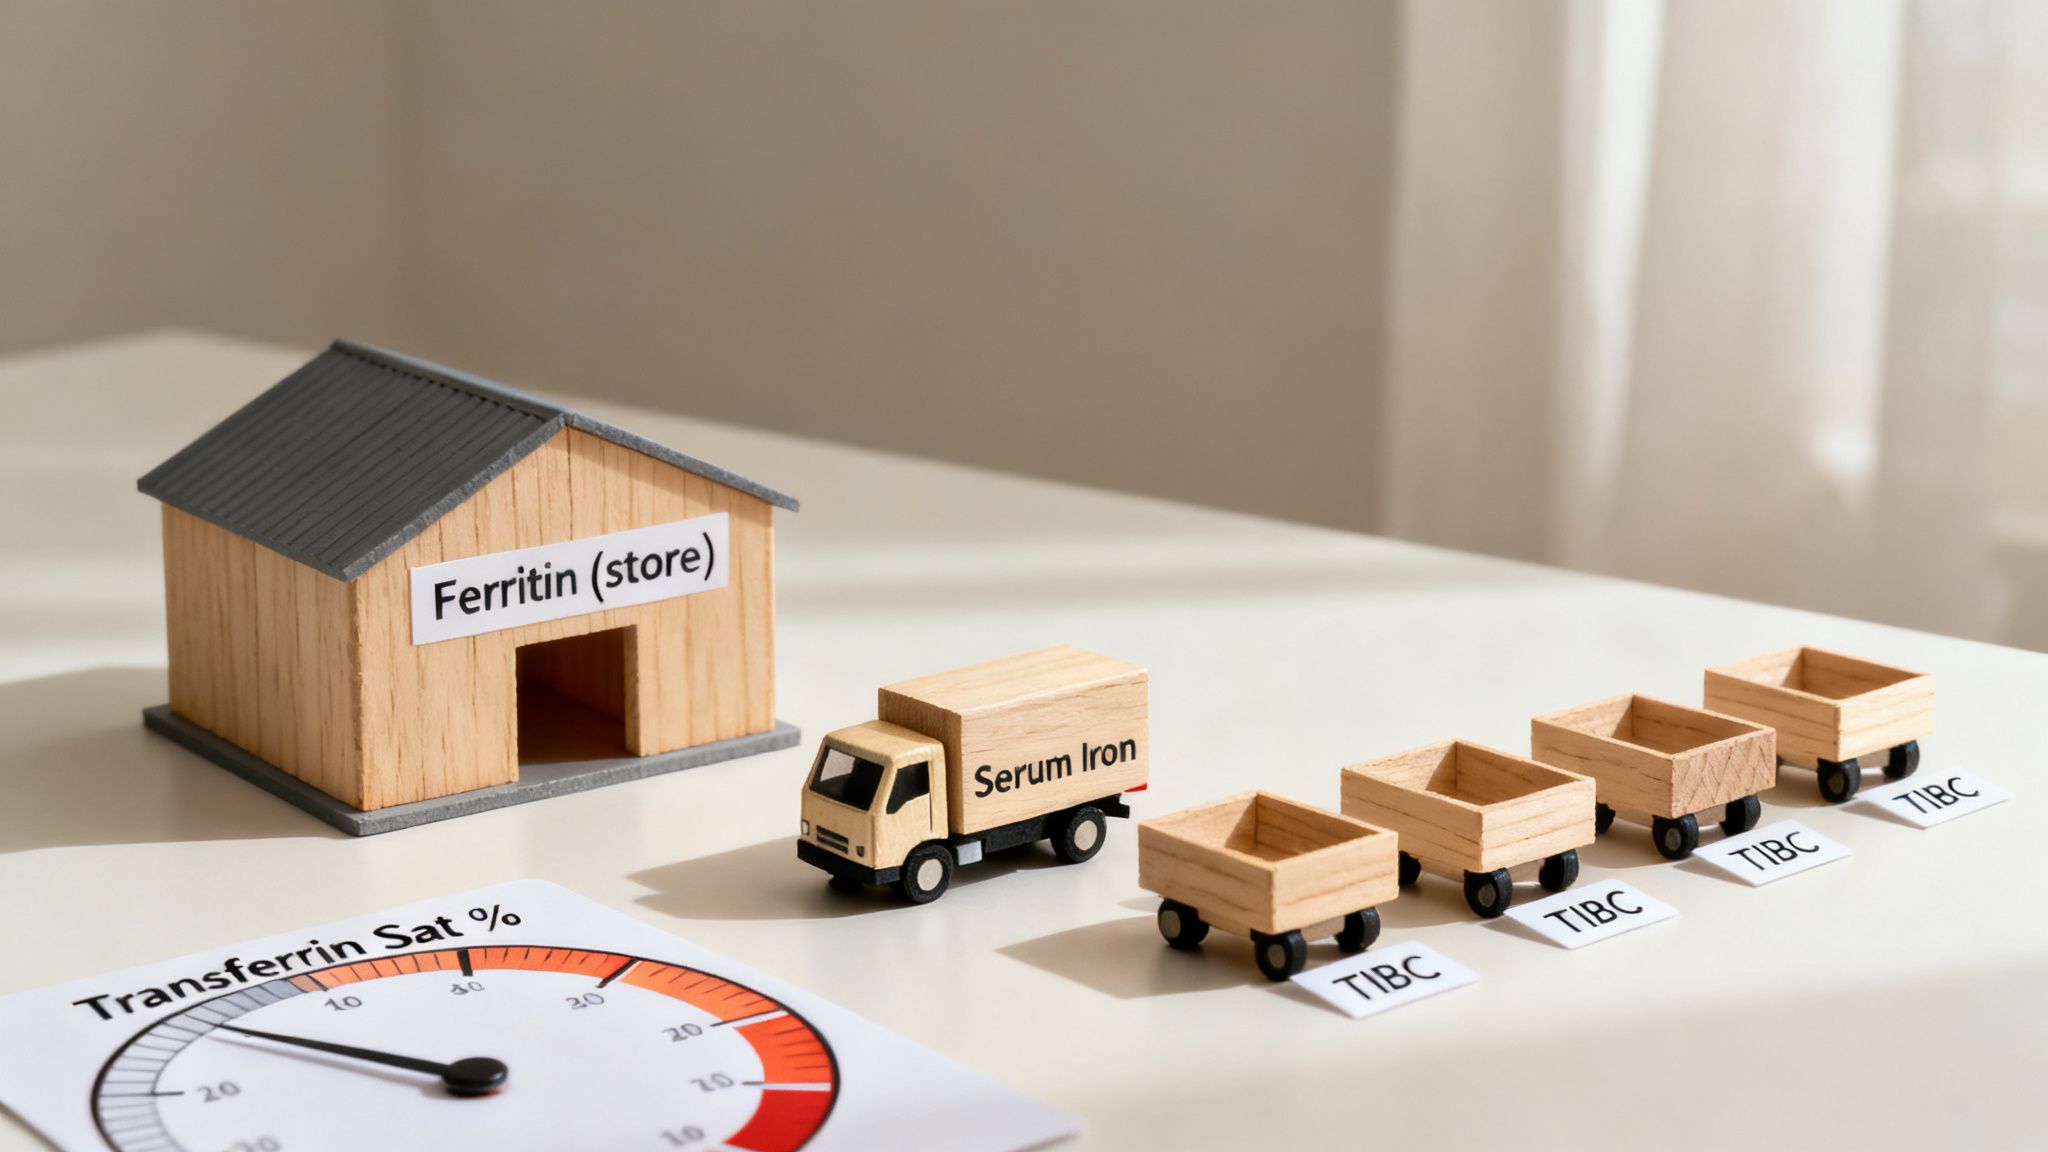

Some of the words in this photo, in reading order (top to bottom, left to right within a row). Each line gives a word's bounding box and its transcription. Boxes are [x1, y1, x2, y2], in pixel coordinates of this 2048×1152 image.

[434, 562, 577, 620] Ferritin
[591, 532, 714, 602] (store)
[974, 755, 1072, 798] Serum
[1082, 738, 1136, 771] Iron
[1891, 776, 1980, 814] TIBC
[1728, 831, 1820, 871] TIBC
[1543, 890, 1643, 933] TIBC
[73, 940, 367, 1020] Transferrin
[373, 916, 464, 950] Sat
[468, 904, 522, 932] %
[1332, 956, 1441, 1000] TIBC
[324, 995, 363, 1012] 10
[197, 1081, 242, 1103] 20
